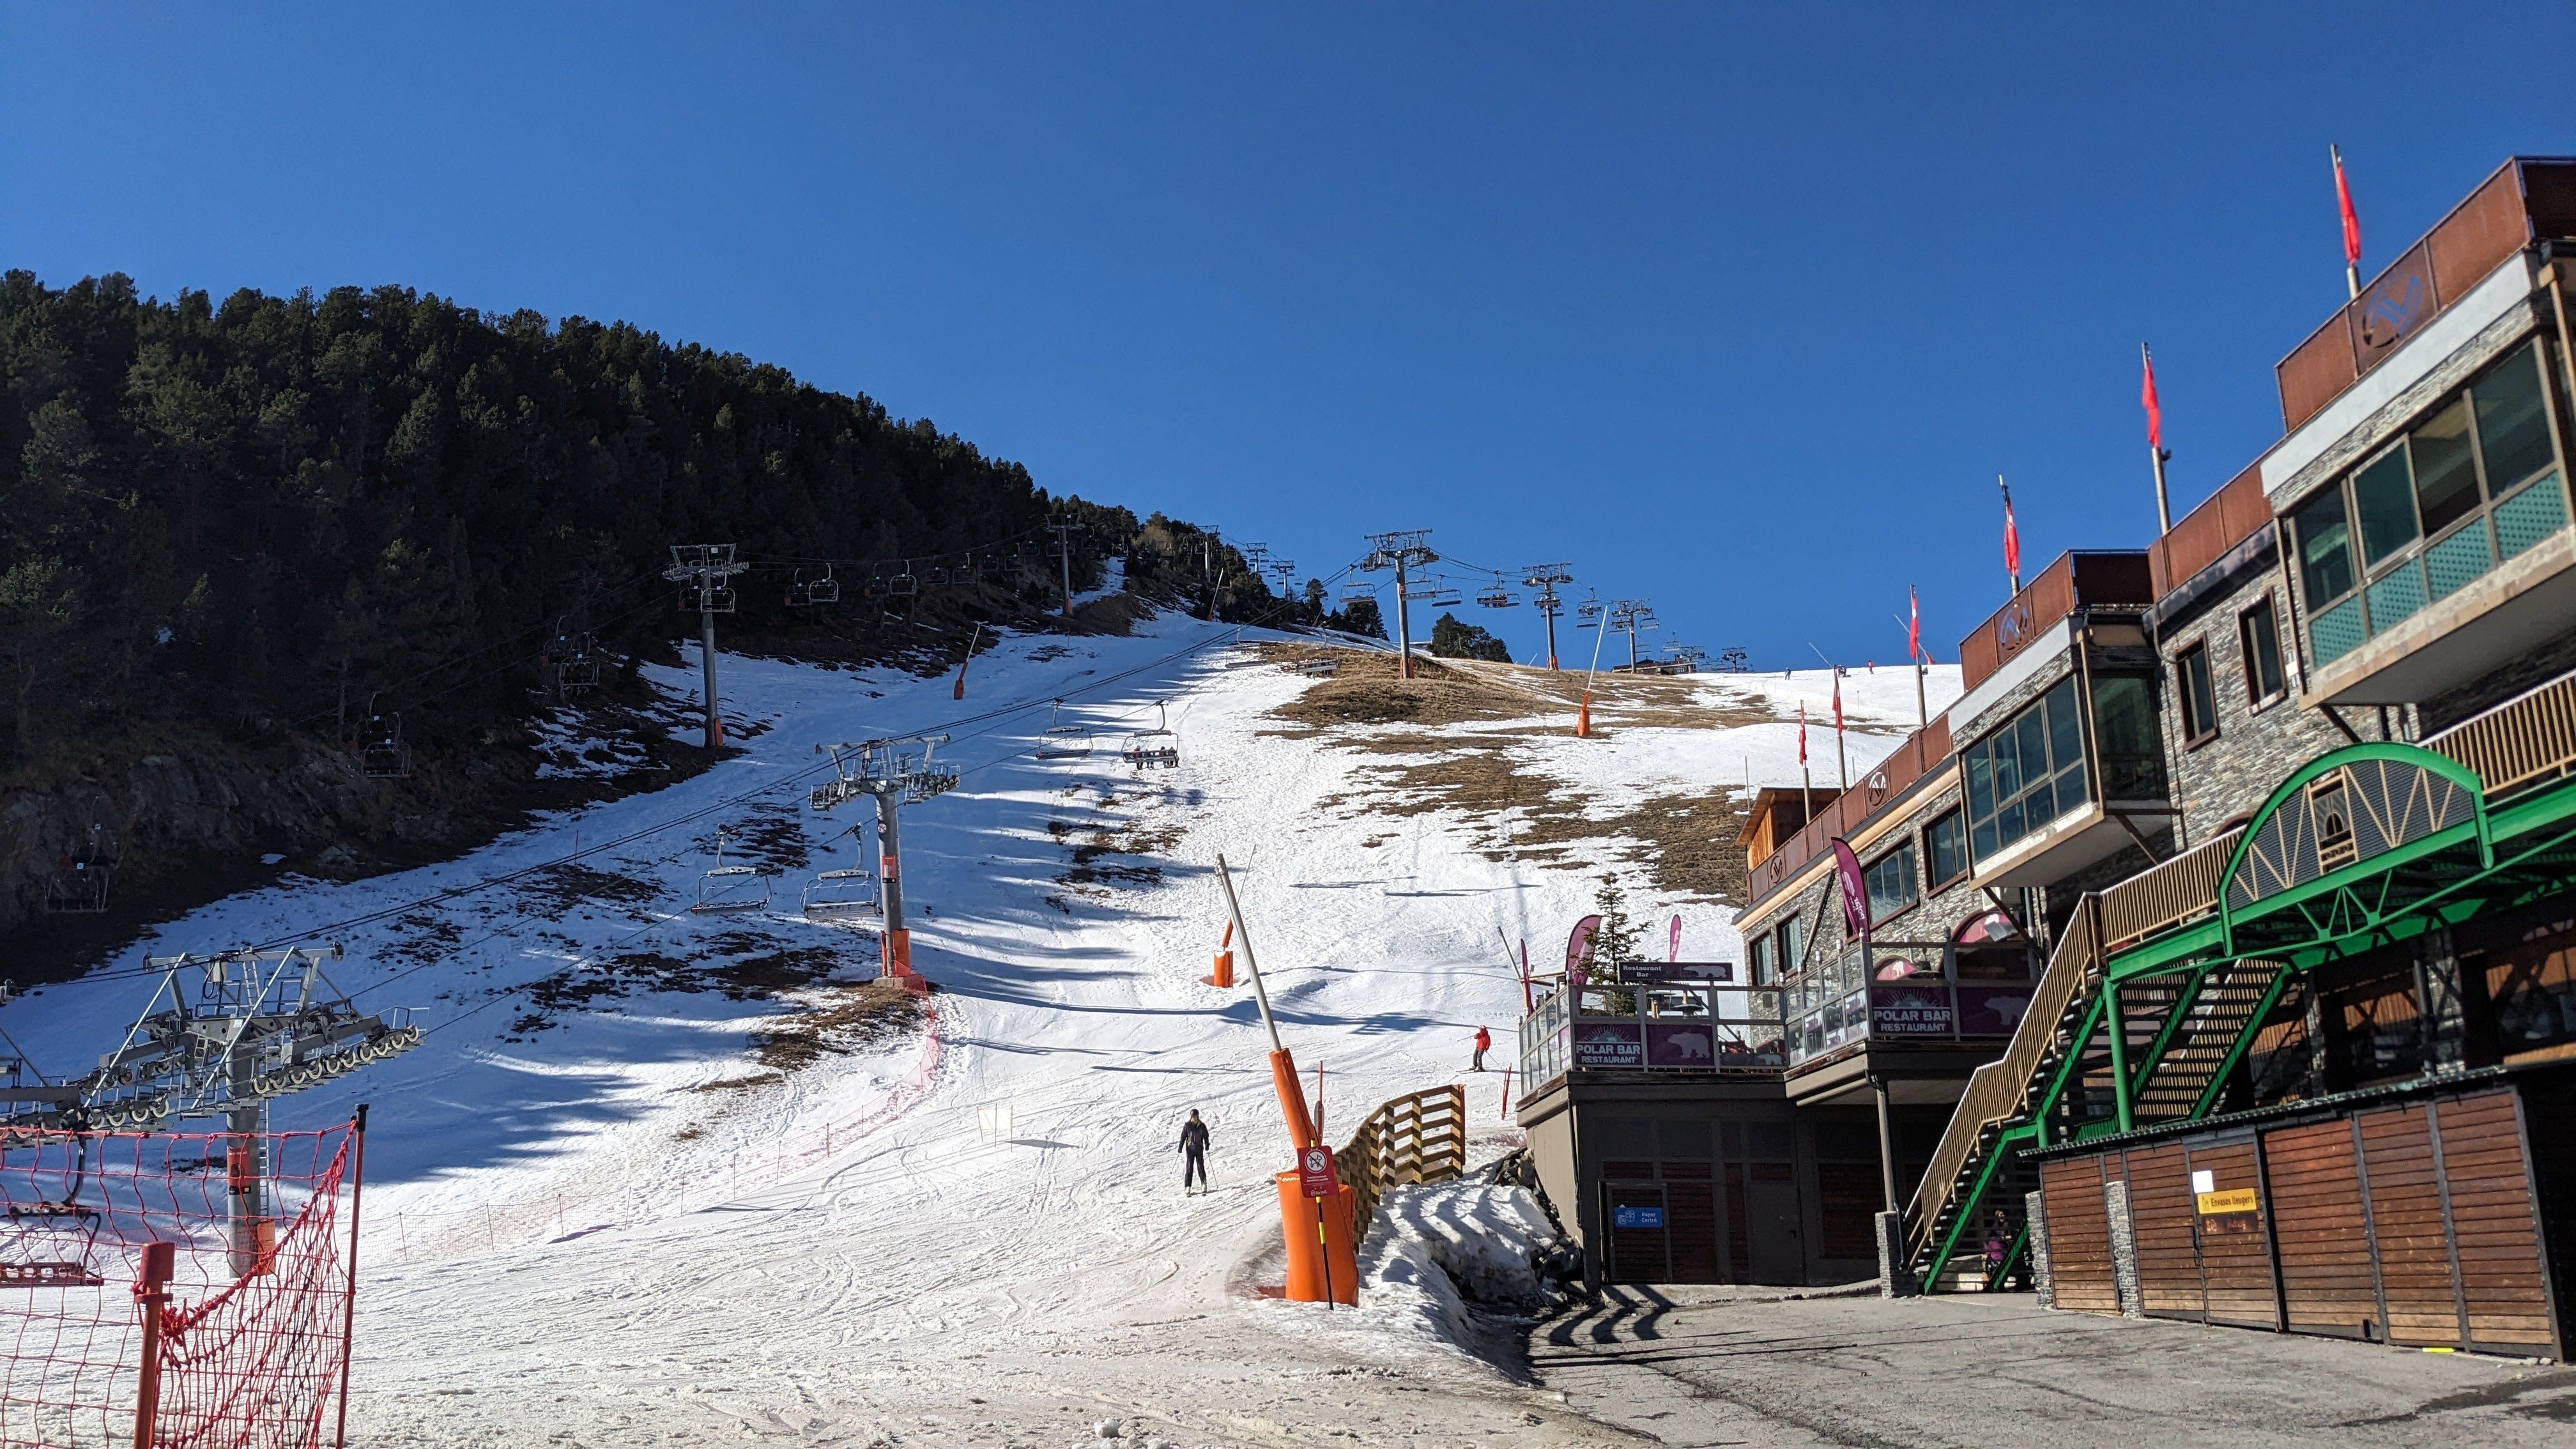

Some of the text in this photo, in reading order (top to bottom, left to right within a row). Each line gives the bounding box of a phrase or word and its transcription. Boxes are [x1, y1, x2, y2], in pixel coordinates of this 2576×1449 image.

[1873, 1010, 1951, 1021] POLAR BAR
[1880, 1023, 1946, 1032] RESTAURANT
[1575, 1044, 1641, 1054] POLAR BAR
[1581, 1055, 1636, 1064] RESTAURANT
